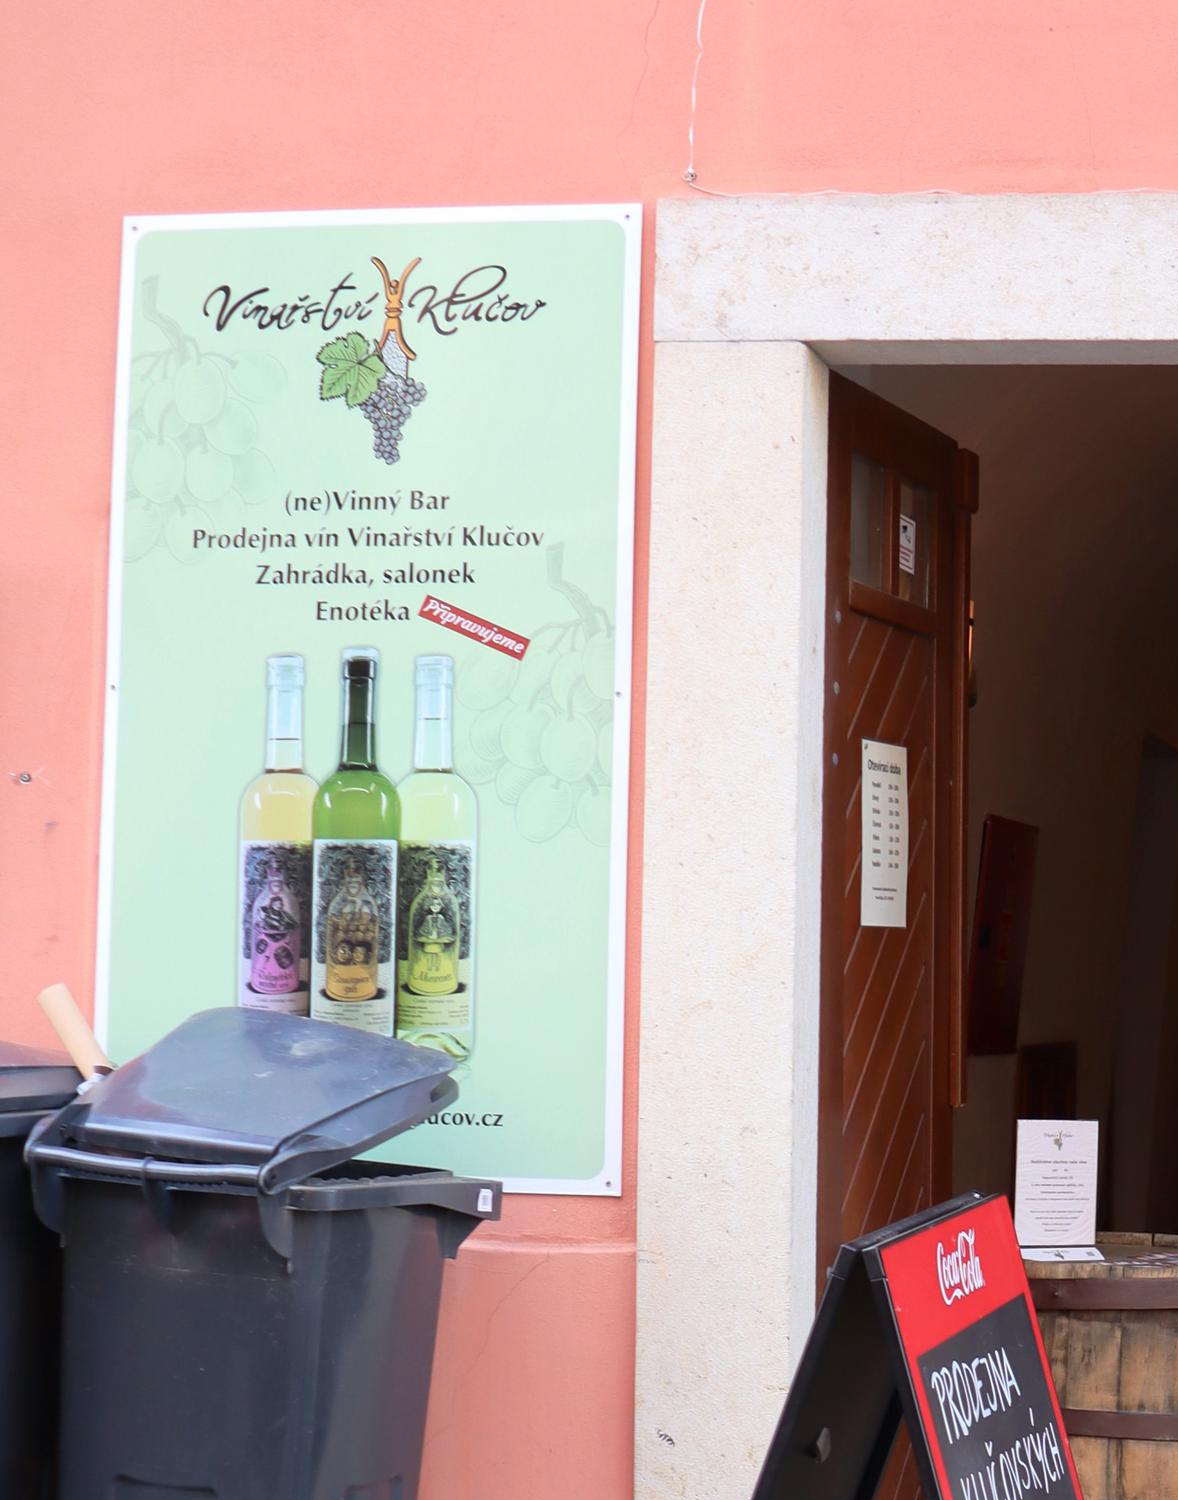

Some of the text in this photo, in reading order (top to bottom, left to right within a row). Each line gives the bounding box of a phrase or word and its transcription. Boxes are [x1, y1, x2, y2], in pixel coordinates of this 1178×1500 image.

[203, 265, 547, 335] Vinařství Klučov
[284, 490, 450, 515] (ne)Vinný Bar
[192, 525, 545, 553] Prodejna vín Vinařství Klučov
[255, 562, 475, 589] Zahrádka, salonek
[315, 600, 411, 622] Enotéka
[422, 599, 526, 655] Připravujeme
[930, 1346, 1021, 1444] PRODEJNA
